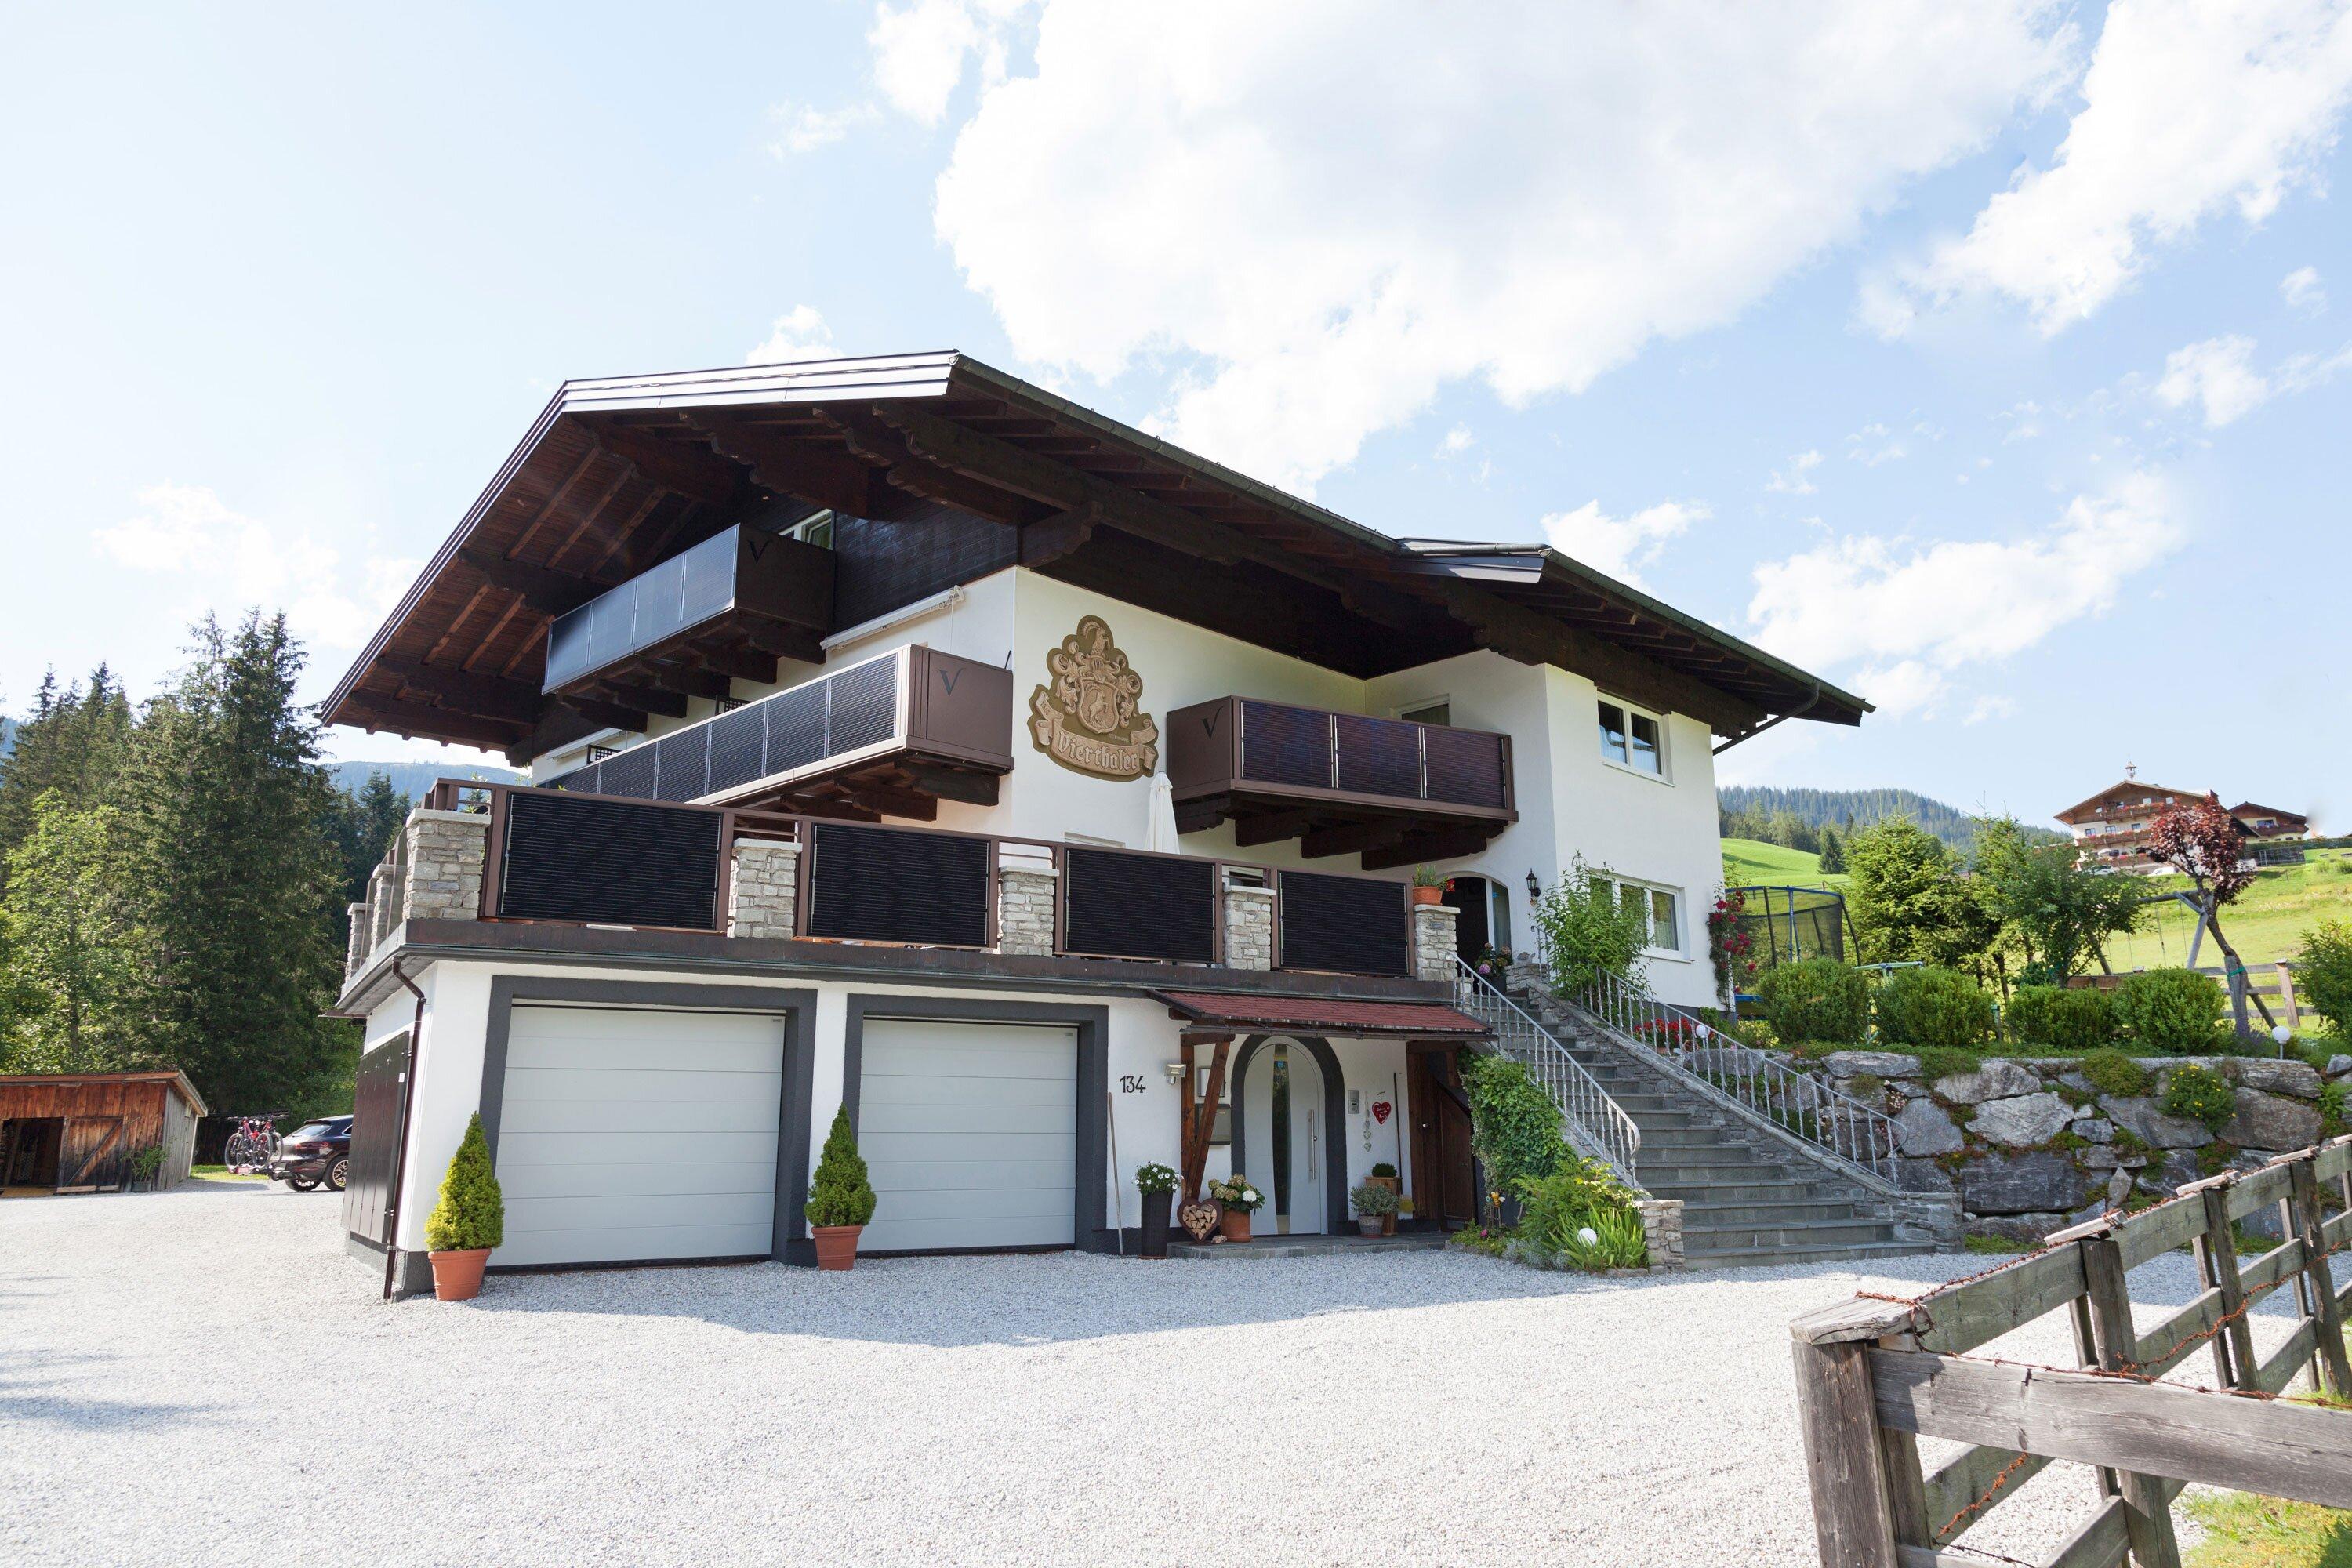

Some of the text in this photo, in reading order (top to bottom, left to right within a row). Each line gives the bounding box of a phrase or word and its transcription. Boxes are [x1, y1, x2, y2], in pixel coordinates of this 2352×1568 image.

[746, 539, 773, 564] V
[937, 667, 965, 697] V
[1201, 706, 1224, 739] V
[1057, 730, 1138, 771] Vierthaler
[1119, 1075, 1146, 1094] 134
